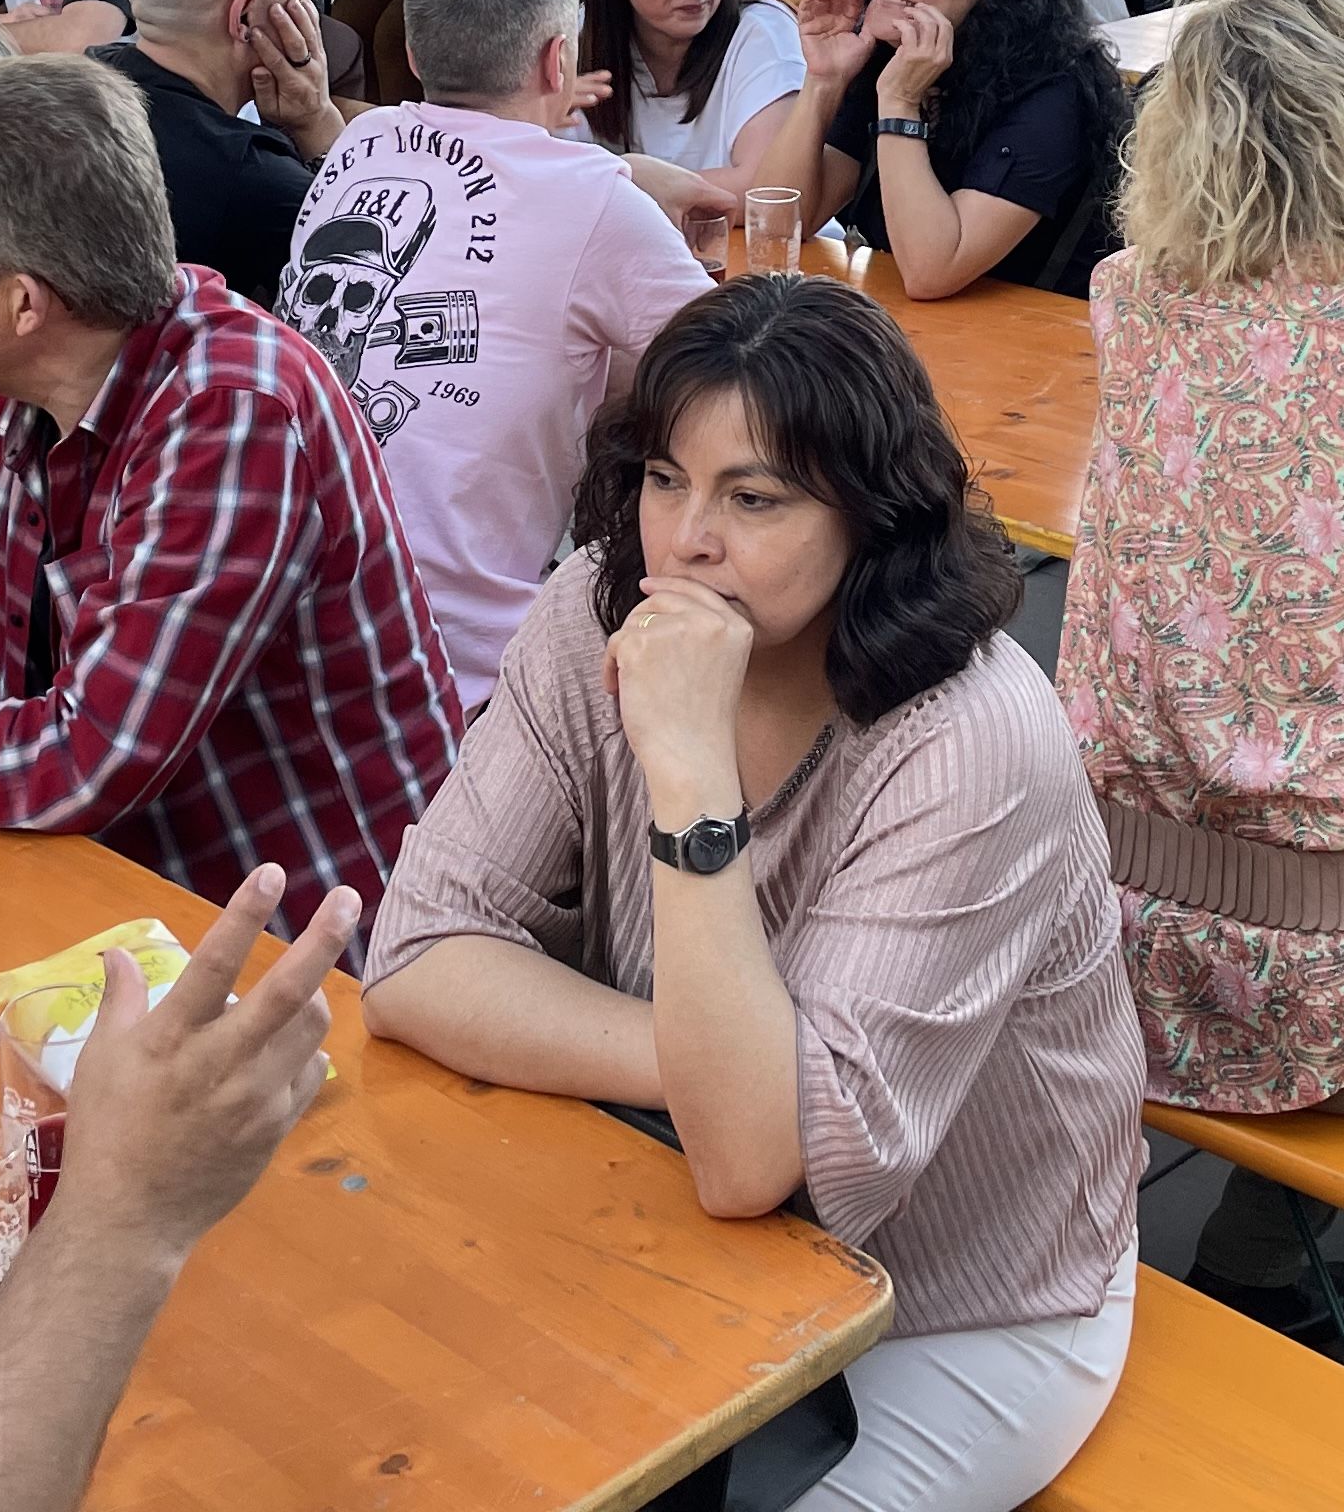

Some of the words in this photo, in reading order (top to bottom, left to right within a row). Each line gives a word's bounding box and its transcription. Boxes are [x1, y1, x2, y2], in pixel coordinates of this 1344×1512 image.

[347, 189, 410, 228] R&L
[394, 123, 497, 203] LONDON
[465, 212, 498, 264] 212
[428, 380, 481, 409] 1969
